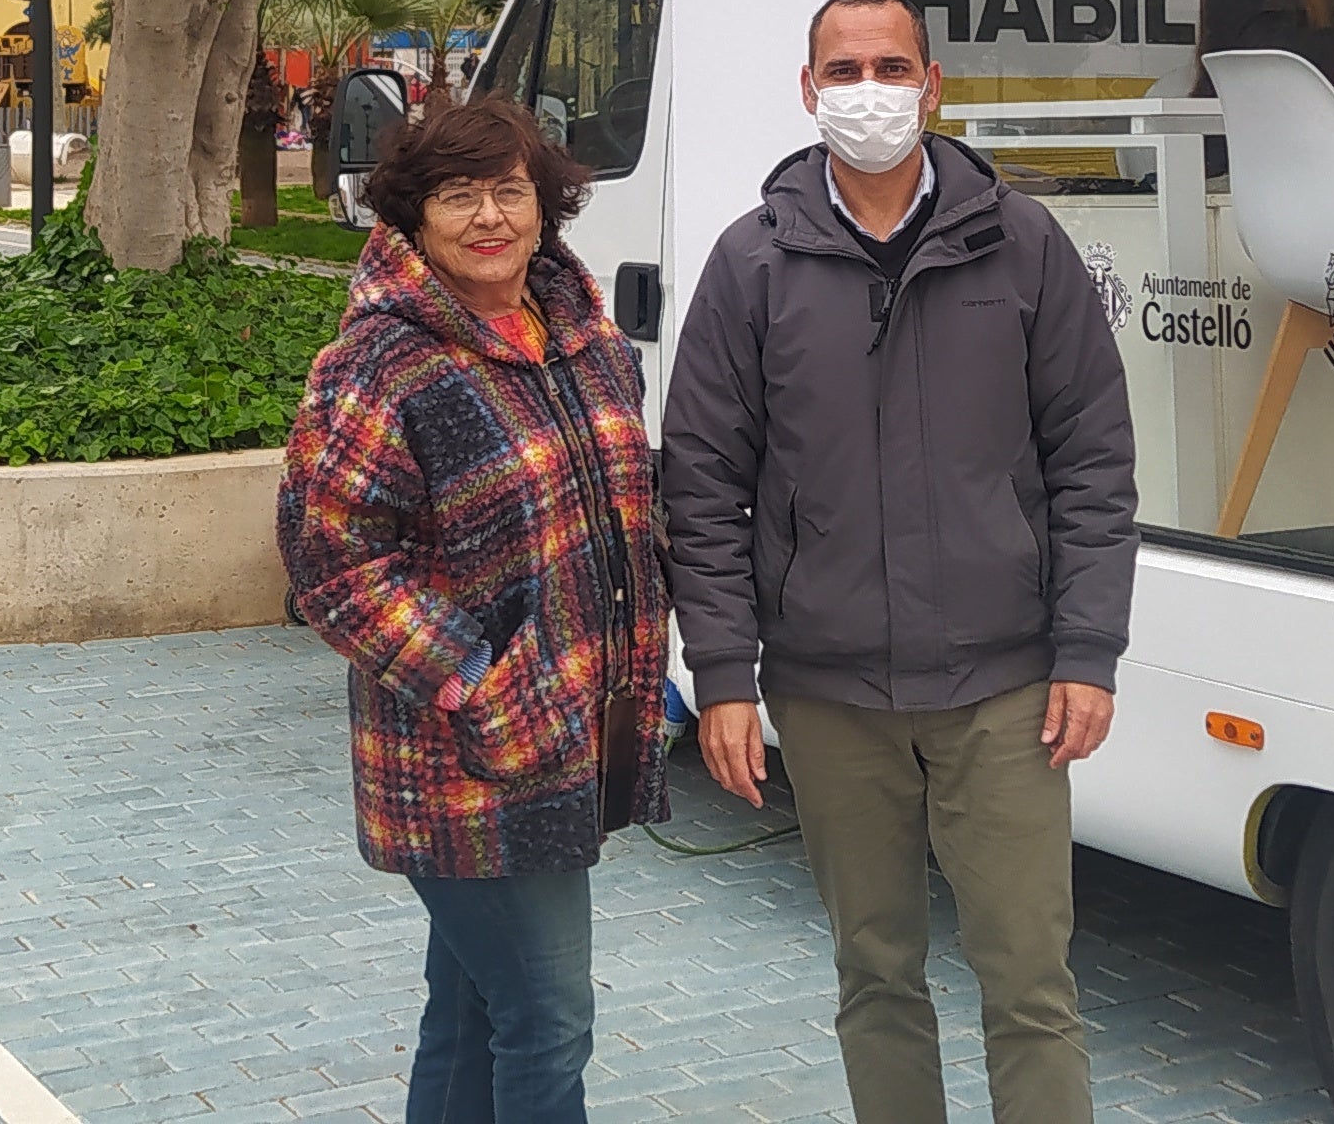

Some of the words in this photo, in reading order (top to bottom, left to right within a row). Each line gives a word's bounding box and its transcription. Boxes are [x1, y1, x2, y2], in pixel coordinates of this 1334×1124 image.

[1141, 272, 1228, 299] Ajuntament
[1231, 278, 1252, 301] de
[1141, 300, 1253, 350] Castelló
